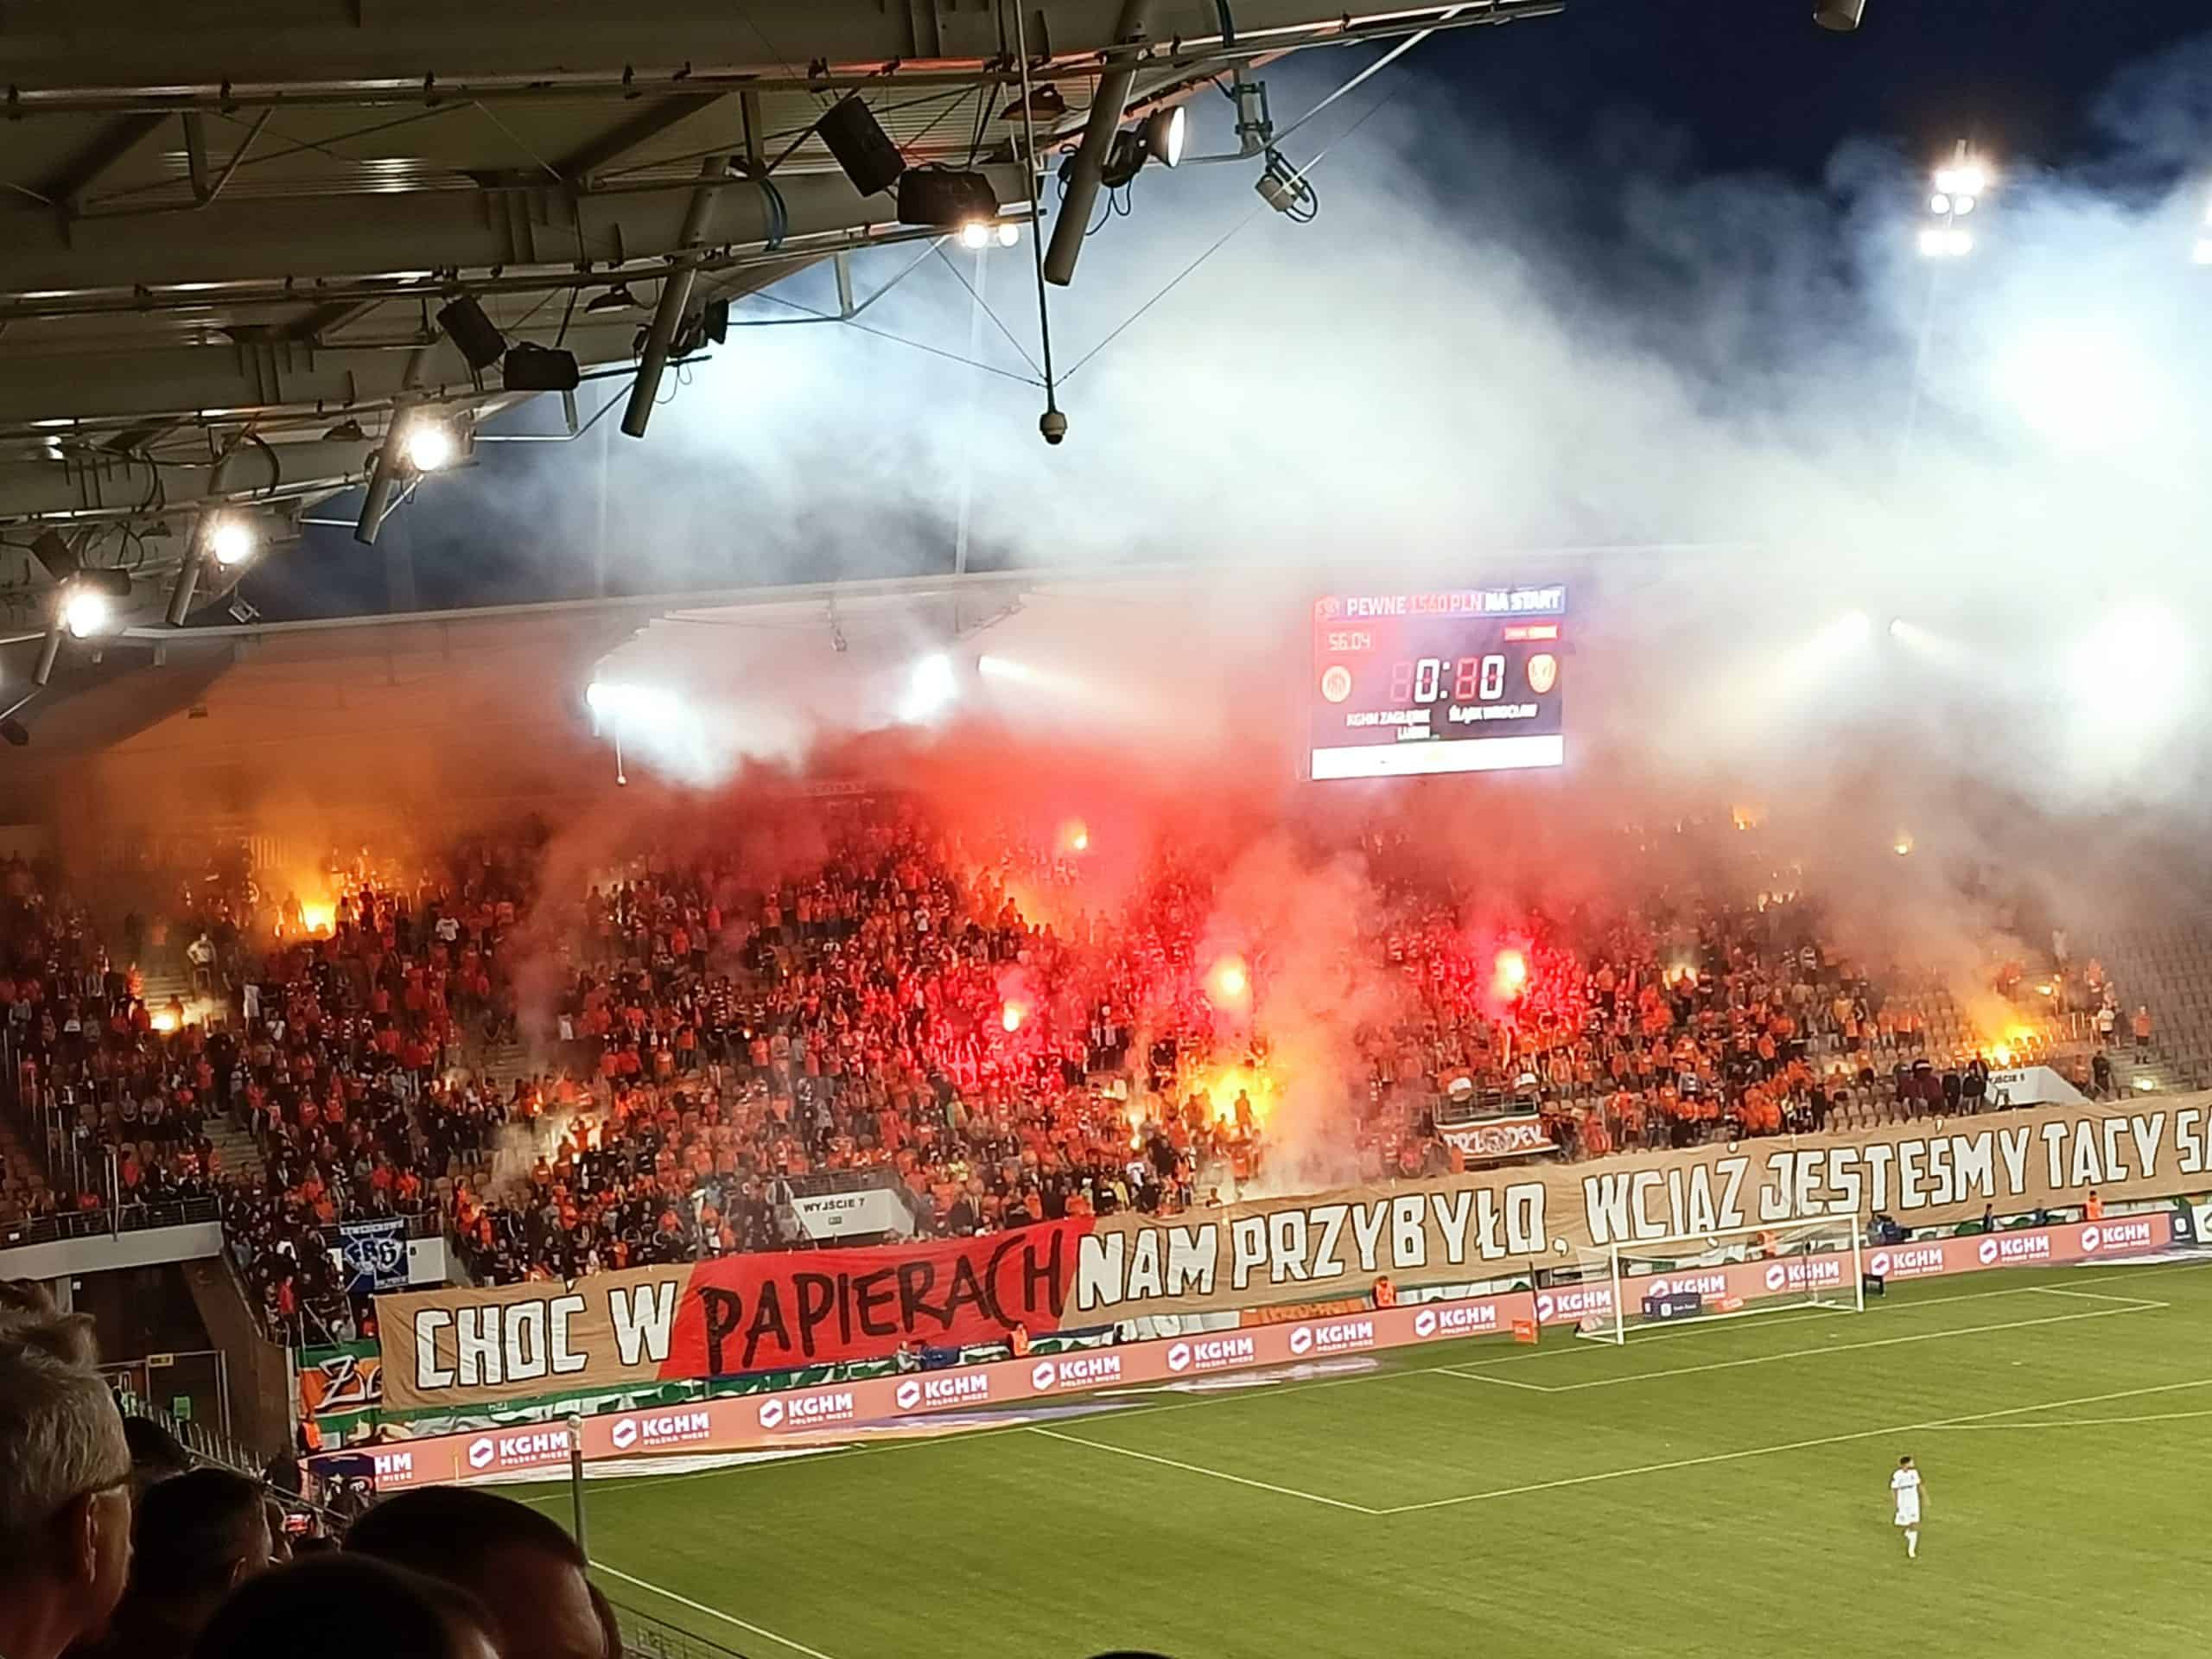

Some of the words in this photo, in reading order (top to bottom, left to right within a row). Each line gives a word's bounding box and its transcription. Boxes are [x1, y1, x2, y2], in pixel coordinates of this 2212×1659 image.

[1348, 595, 1407, 615] PEWNE
[1451, 593, 1483, 613] PLN
[803, 1199, 855, 1213] WYJŚCIE
[2101, 1223, 2151, 1243] KGHM
[415, 1278, 588, 1389] CHOĆ
[607, 1281, 678, 1367] W
[697, 1229, 1065, 1376] PAPIERACH
[1077, 1223, 1219, 1312] NAM
[1758, 1120, 2031, 1222] JESTEŚMY
[2040, 1110, 2167, 1190] TACY
[2176, 1103, 2212, 1176] S
[2000, 1235, 2050, 1257] KGHM
[1892, 1248, 1942, 1270] KGHM
[1557, 1289, 1612, 1313] KGHM
[1439, 1305, 1497, 1328] KGHM
[1315, 1320, 1374, 1344] KGHM
[1193, 1337, 1253, 1361] KGHM
[1058, 1355, 1121, 1381] KGHM
[925, 1374, 988, 1400] KGHM
[787, 1392, 854, 1418] KGHM
[641, 1412, 709, 1439] KGHM
[499, 1431, 569, 1457] KGHM
[374, 1452, 413, 1475] HM
